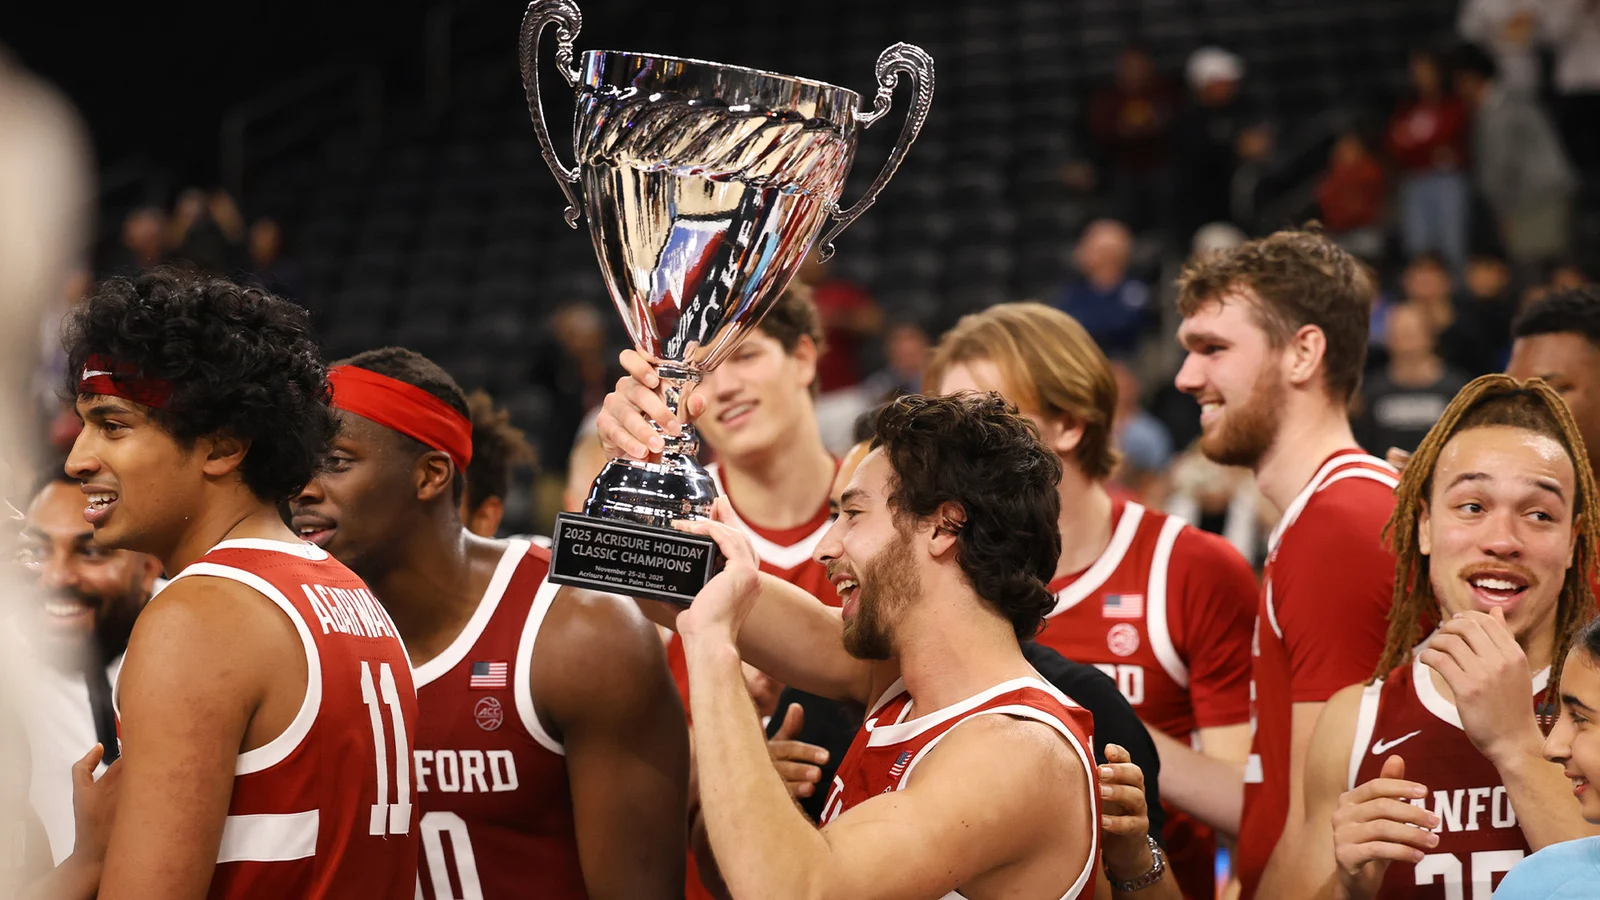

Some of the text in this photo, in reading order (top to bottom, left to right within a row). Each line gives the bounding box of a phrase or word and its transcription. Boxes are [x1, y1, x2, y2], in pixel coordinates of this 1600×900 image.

[564, 528, 704, 559] 2025 ACRISURE HOLIDAY
[572, 544, 692, 573] CLASSIC CHAMPIONS
[578, 570, 604, 580] Acrisure
[604, 574, 623, 583] Arena
[628, 578, 644, 587] Palm
[645, 581, 667, 591] Desert,
[667, 584, 678, 592] CA
[595, 565, 664, 582] November 25-28, 2025
[360, 661, 412, 835] 11
[413, 750, 519, 793] FORD
